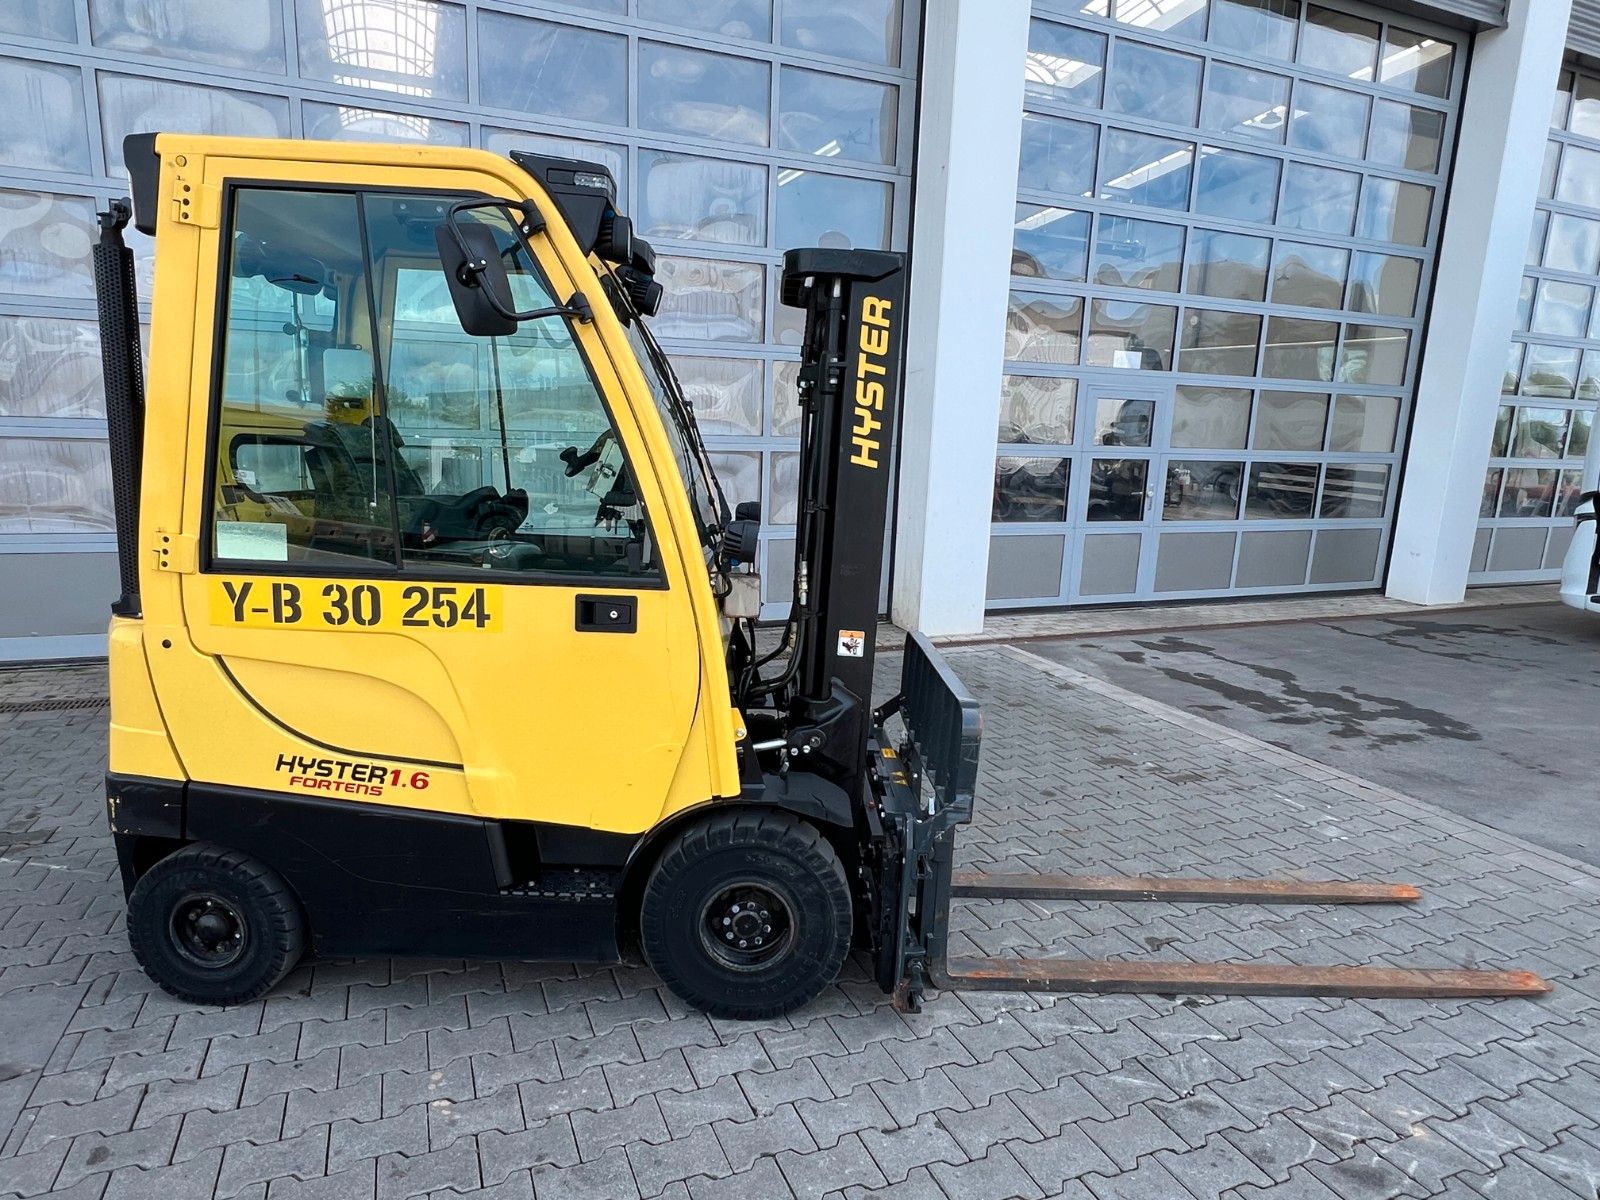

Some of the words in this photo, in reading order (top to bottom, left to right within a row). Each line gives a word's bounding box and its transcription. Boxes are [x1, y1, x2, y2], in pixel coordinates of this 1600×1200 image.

[850, 295, 892, 469] HYSTER
[222, 581, 303, 624] Y-B
[321, 583, 382, 626] 30
[401, 585, 491, 629] 254
[275, 753, 388, 785] HYSTER
[389, 768, 430, 790] 1.6
[289, 775, 384, 797] FORTENS
